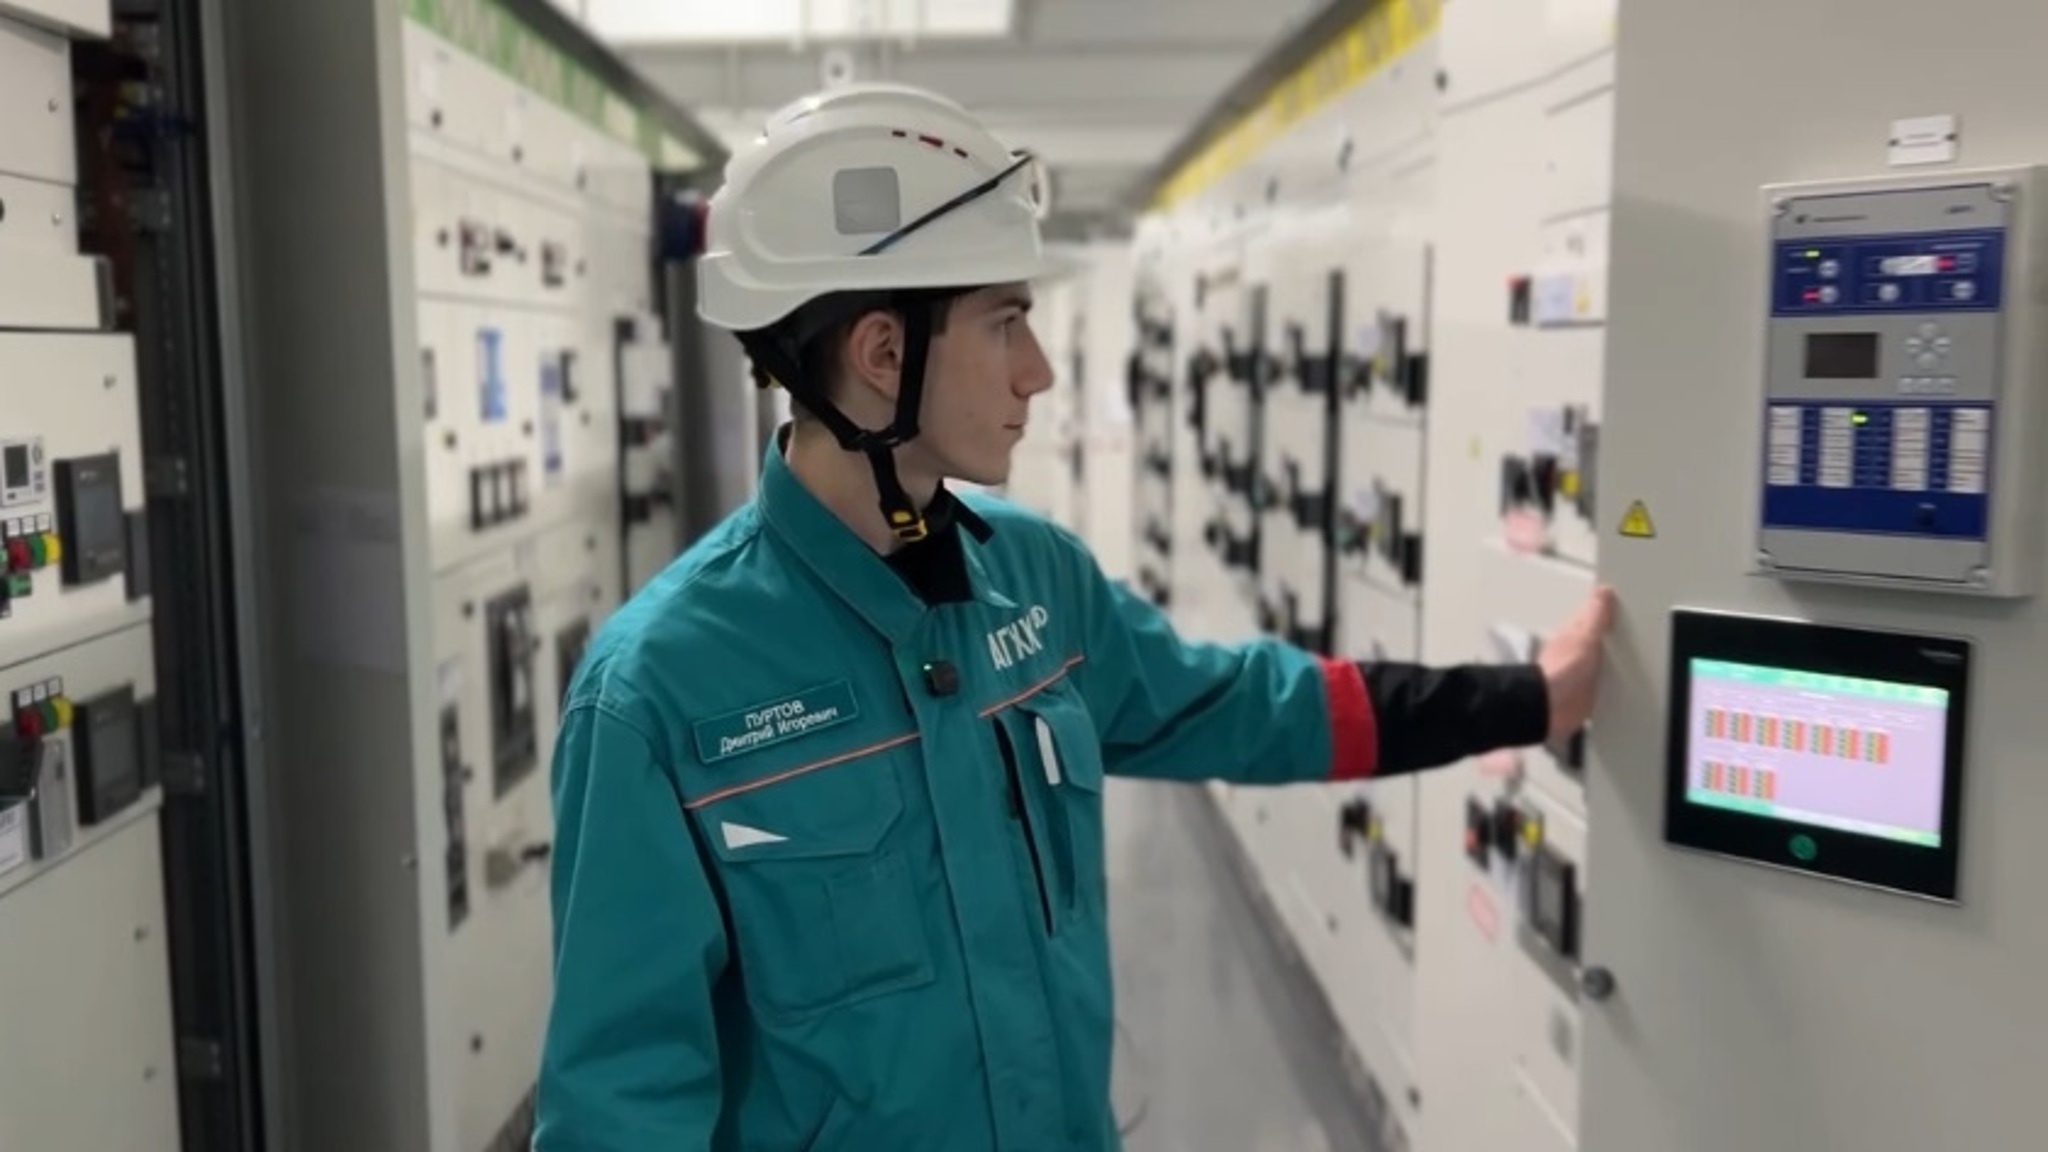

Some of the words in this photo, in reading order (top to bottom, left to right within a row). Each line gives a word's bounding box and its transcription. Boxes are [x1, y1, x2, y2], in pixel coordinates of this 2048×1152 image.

[720, 725, 774, 753] Дмитрий
[777, 707, 837, 735] Игоревич
[745, 700, 805, 729] ПУРТОВ
